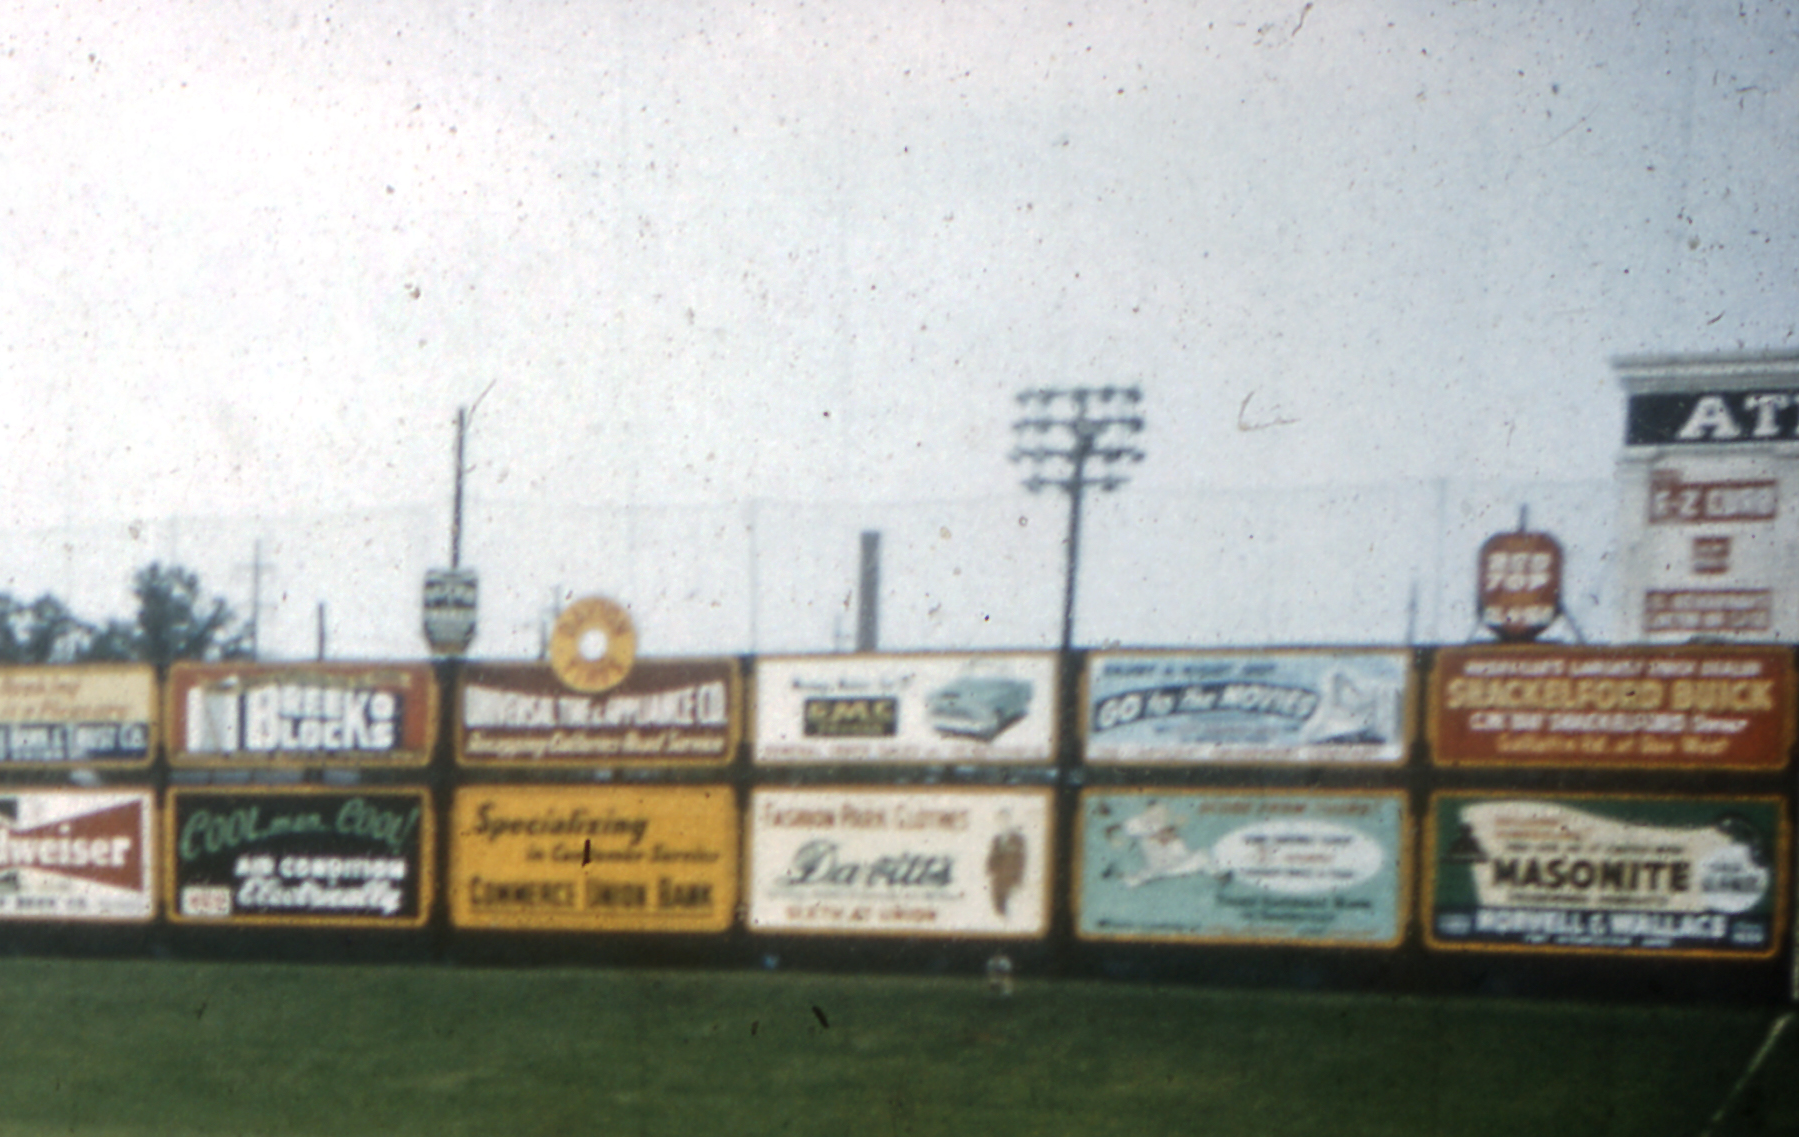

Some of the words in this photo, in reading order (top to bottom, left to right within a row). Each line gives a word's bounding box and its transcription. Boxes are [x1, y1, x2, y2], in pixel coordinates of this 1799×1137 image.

[1676, 395, 1799, 440] AT
[1096, 692, 1144, 731] GO
[1671, 679, 1775, 712] BUICK
[471, 801, 649, 847] Specializing
[279, 855, 406, 879] CONDITION
[1492, 857, 1695, 894] MASONITE
[469, 876, 577, 907] COMMERCE
[585, 876, 647, 908] UNION
[657, 876, 713, 908] BANK
[1612, 912, 1729, 940] WALLACE
